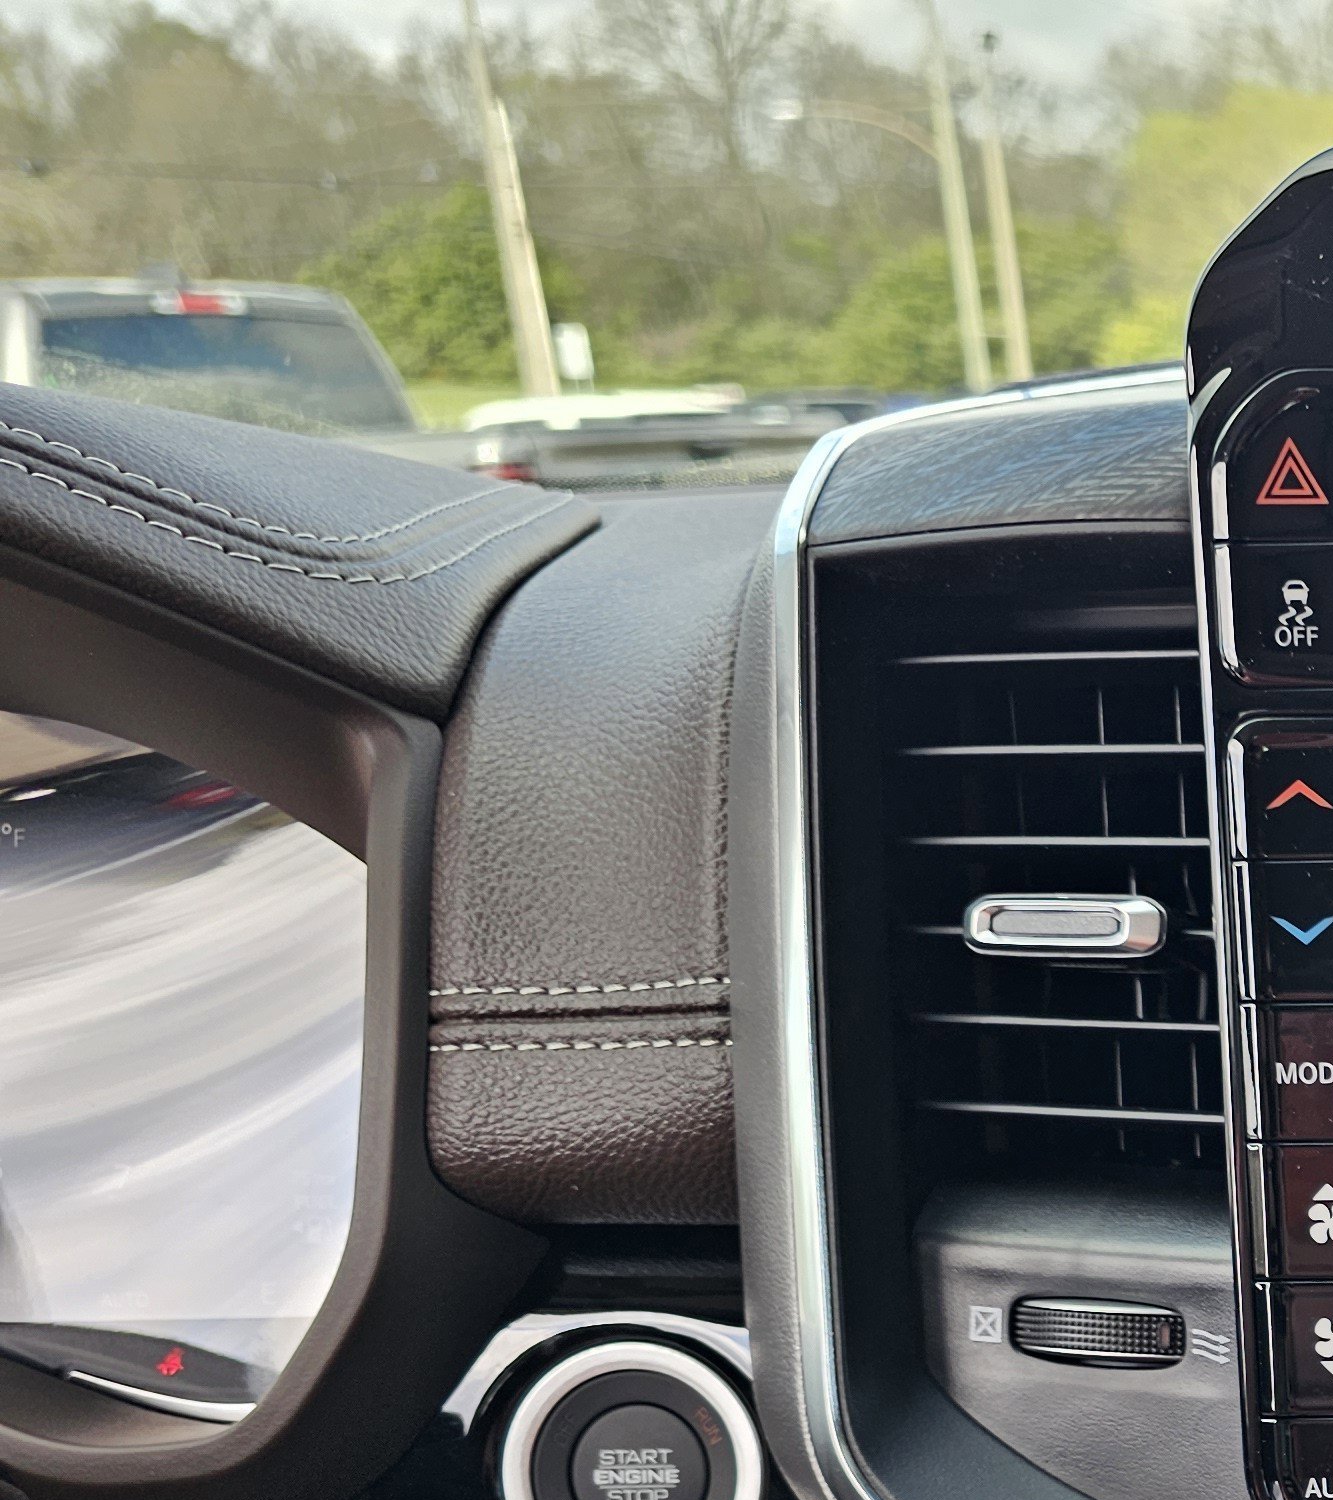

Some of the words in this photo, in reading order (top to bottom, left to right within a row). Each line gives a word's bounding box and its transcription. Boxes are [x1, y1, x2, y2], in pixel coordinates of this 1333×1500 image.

[1274, 626, 1319, 647] OFF
[599, 1448, 674, 1465] START
[593, 1469, 680, 1485] ENGINE
